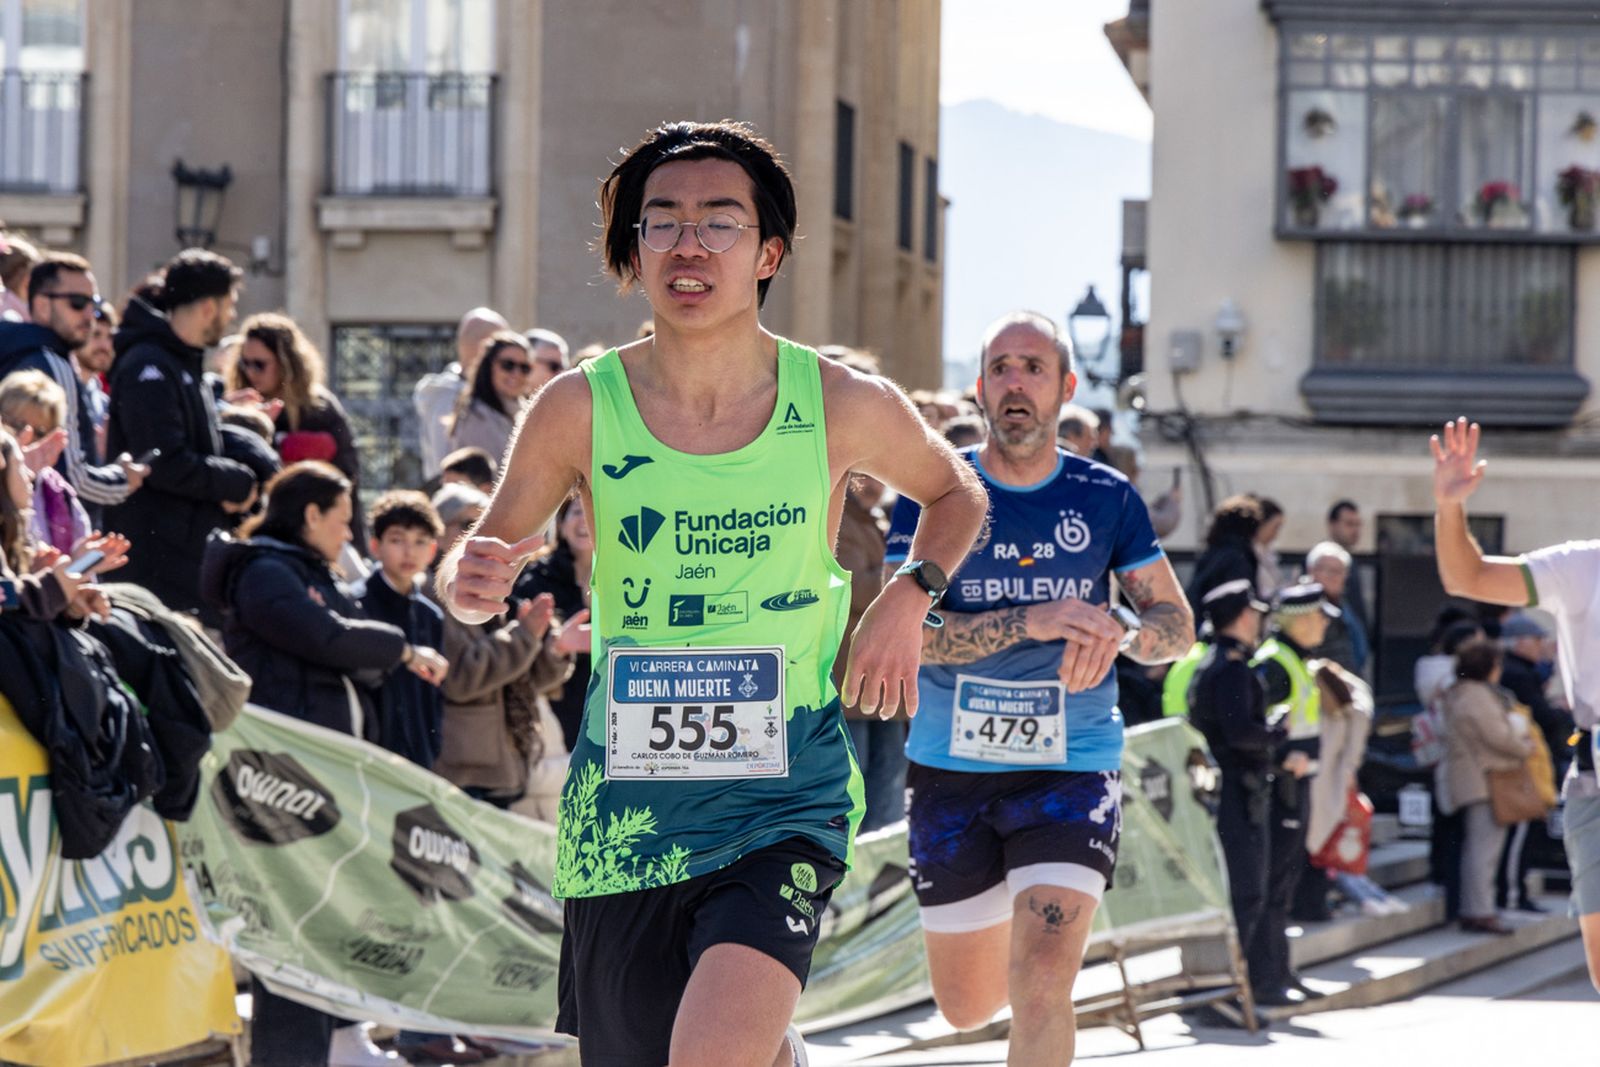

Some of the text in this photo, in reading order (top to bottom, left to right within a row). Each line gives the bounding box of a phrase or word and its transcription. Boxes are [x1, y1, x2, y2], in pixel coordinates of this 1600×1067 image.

[674, 502, 806, 532] Fundación
[675, 530, 771, 559] Unicaja
[993, 543, 1055, 560] RA 28
[675, 563, 716, 580] Jaén
[984, 578, 1094, 600] BULEVAR
[629, 659, 759, 673] VI CARRERA CAMINATA
[628, 679, 732, 698] BUENA MUERTE
[648, 705, 738, 751] 555
[978, 717, 1039, 745] 479
[631, 751, 658, 760] CARLOS
[659, 751, 680, 760] COBO
[682, 751, 692, 759] DE
[693, 750, 726, 760] GUZMÁN
[728, 750, 759, 759] ROMERO
